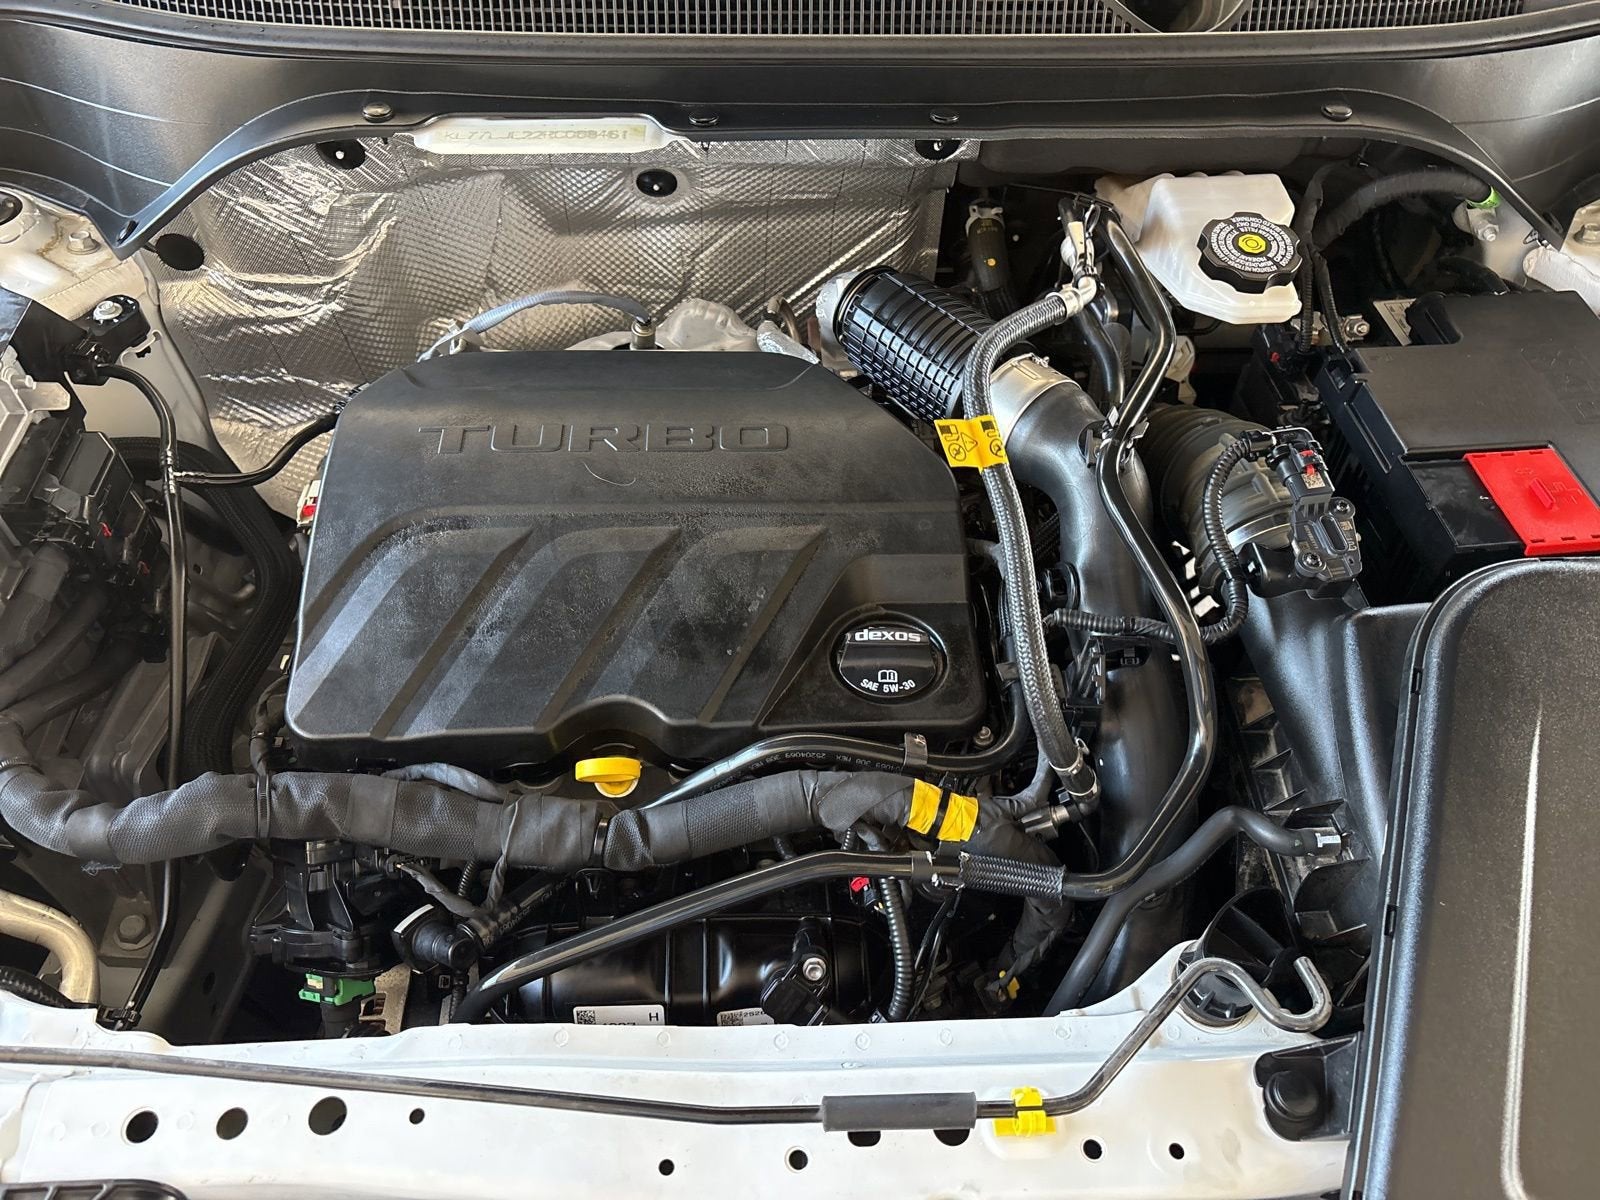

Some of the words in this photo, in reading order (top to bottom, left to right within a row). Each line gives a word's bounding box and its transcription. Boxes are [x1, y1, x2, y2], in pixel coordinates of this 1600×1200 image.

[418, 424, 789, 454] TURBO
[854, 628, 921, 642] dexos
[860, 679, 879, 691] SAE
[883, 679, 916, 693] 5W-30
[649, 1012, 659, 1021] H
